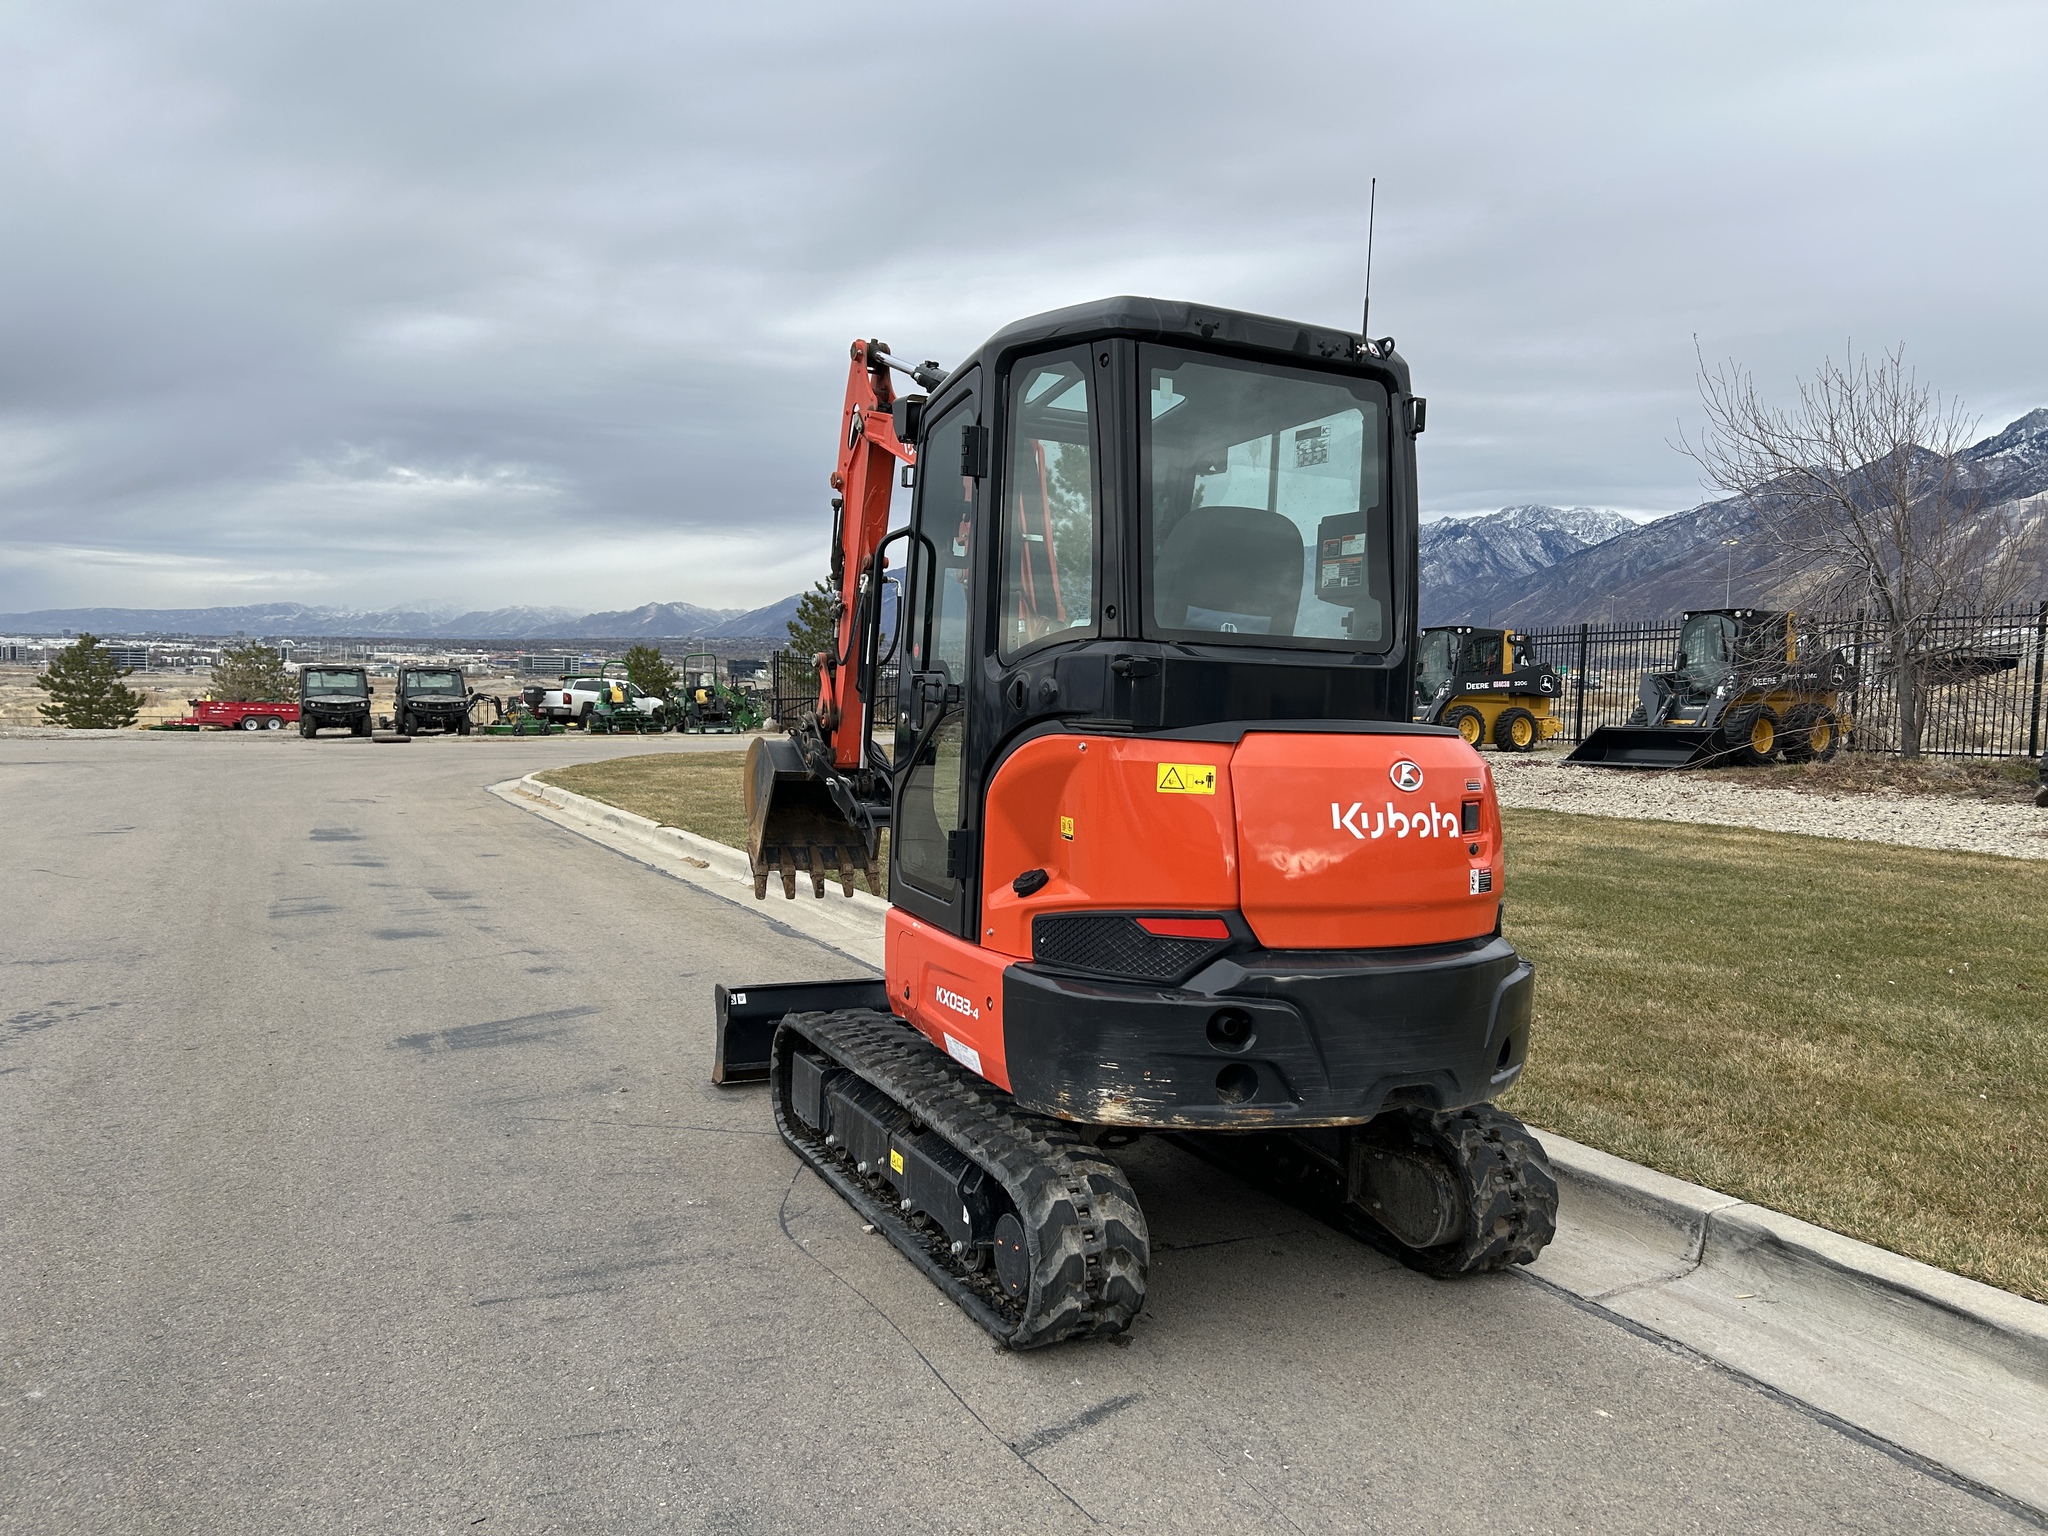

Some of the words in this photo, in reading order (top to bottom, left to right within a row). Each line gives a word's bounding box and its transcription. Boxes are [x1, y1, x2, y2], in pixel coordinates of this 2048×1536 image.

[1466, 682, 1490, 690] DEERE
[1331, 802, 1460, 839] Kubota
[936, 986, 979, 1020] KX033-4
